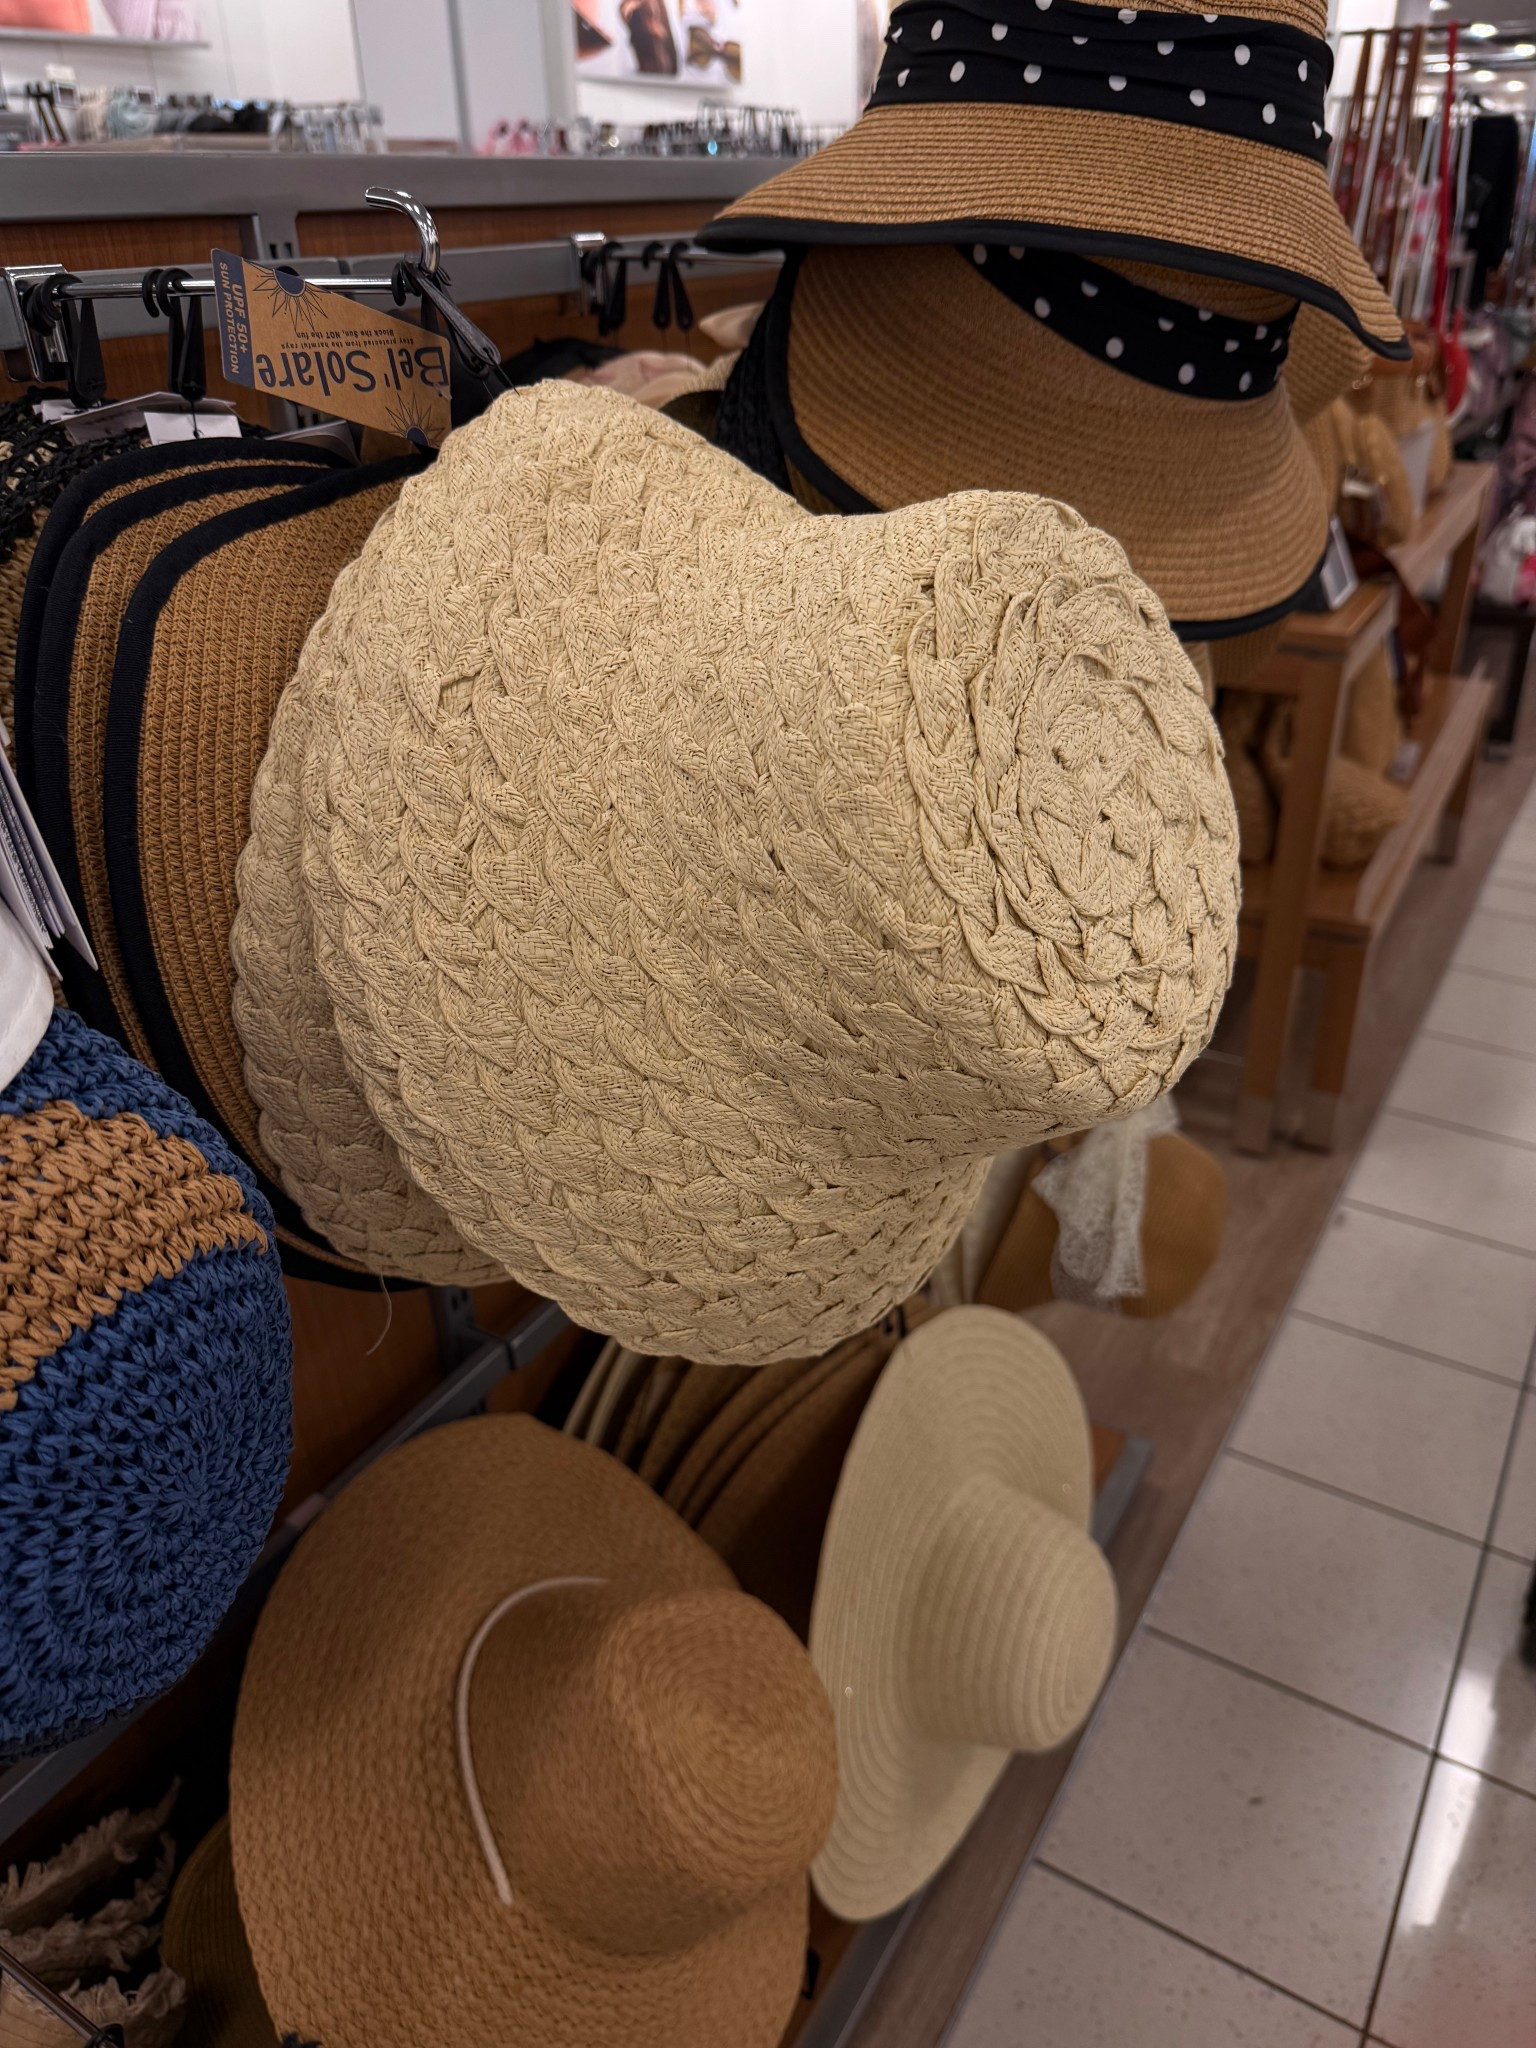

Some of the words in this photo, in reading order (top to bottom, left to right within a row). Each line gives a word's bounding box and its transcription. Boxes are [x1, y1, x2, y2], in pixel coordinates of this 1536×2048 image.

[219, 262, 230, 288] SUN
[231, 283, 246, 319] UPF
[223, 292, 240, 374] PROTECTION
[236, 322, 248, 354] 50+
[325, 331, 341, 339] NOT
[342, 330, 359, 338] Sun,
[300, 341, 329, 349] harmful
[363, 339, 397, 347] protected
